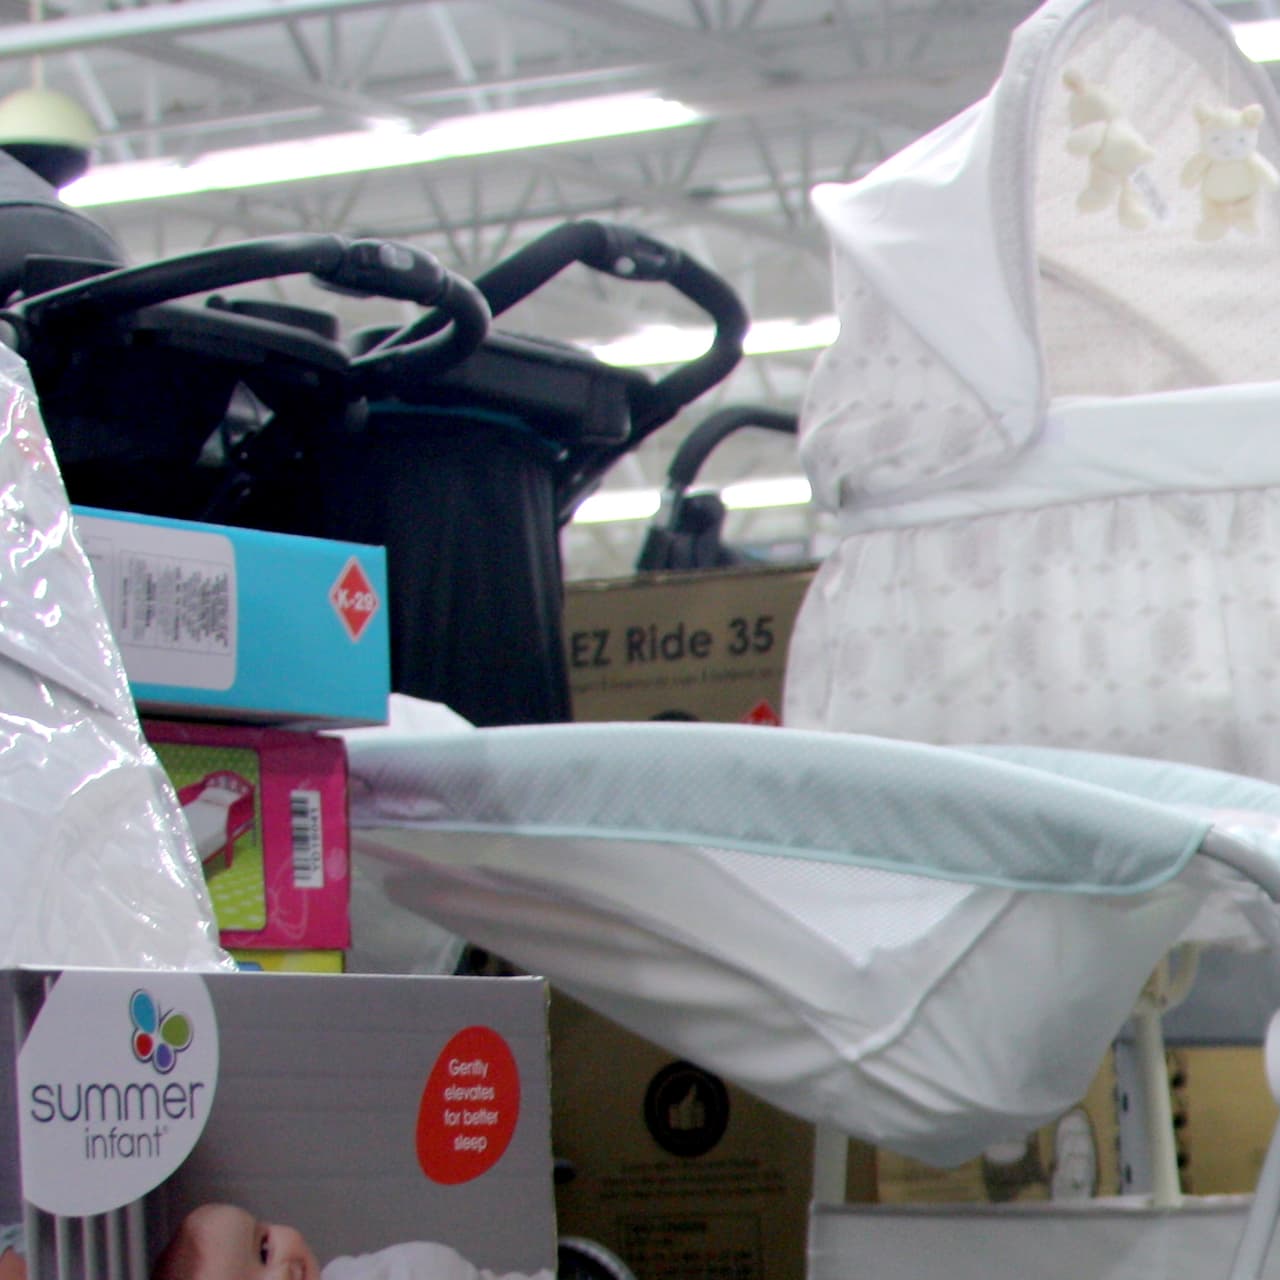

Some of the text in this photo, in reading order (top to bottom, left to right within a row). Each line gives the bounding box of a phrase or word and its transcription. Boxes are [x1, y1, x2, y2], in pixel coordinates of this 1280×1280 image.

[571, 615, 775, 669] EZ Ride 35
[448, 1057, 489, 1079] Gently
[30, 1081, 205, 1123] summer
[444, 1086, 495, 1101] elevates
[444, 1108, 500, 1127] for better
[85, 1127, 163, 1160] infant
[453, 1134, 488, 1154] sleep
